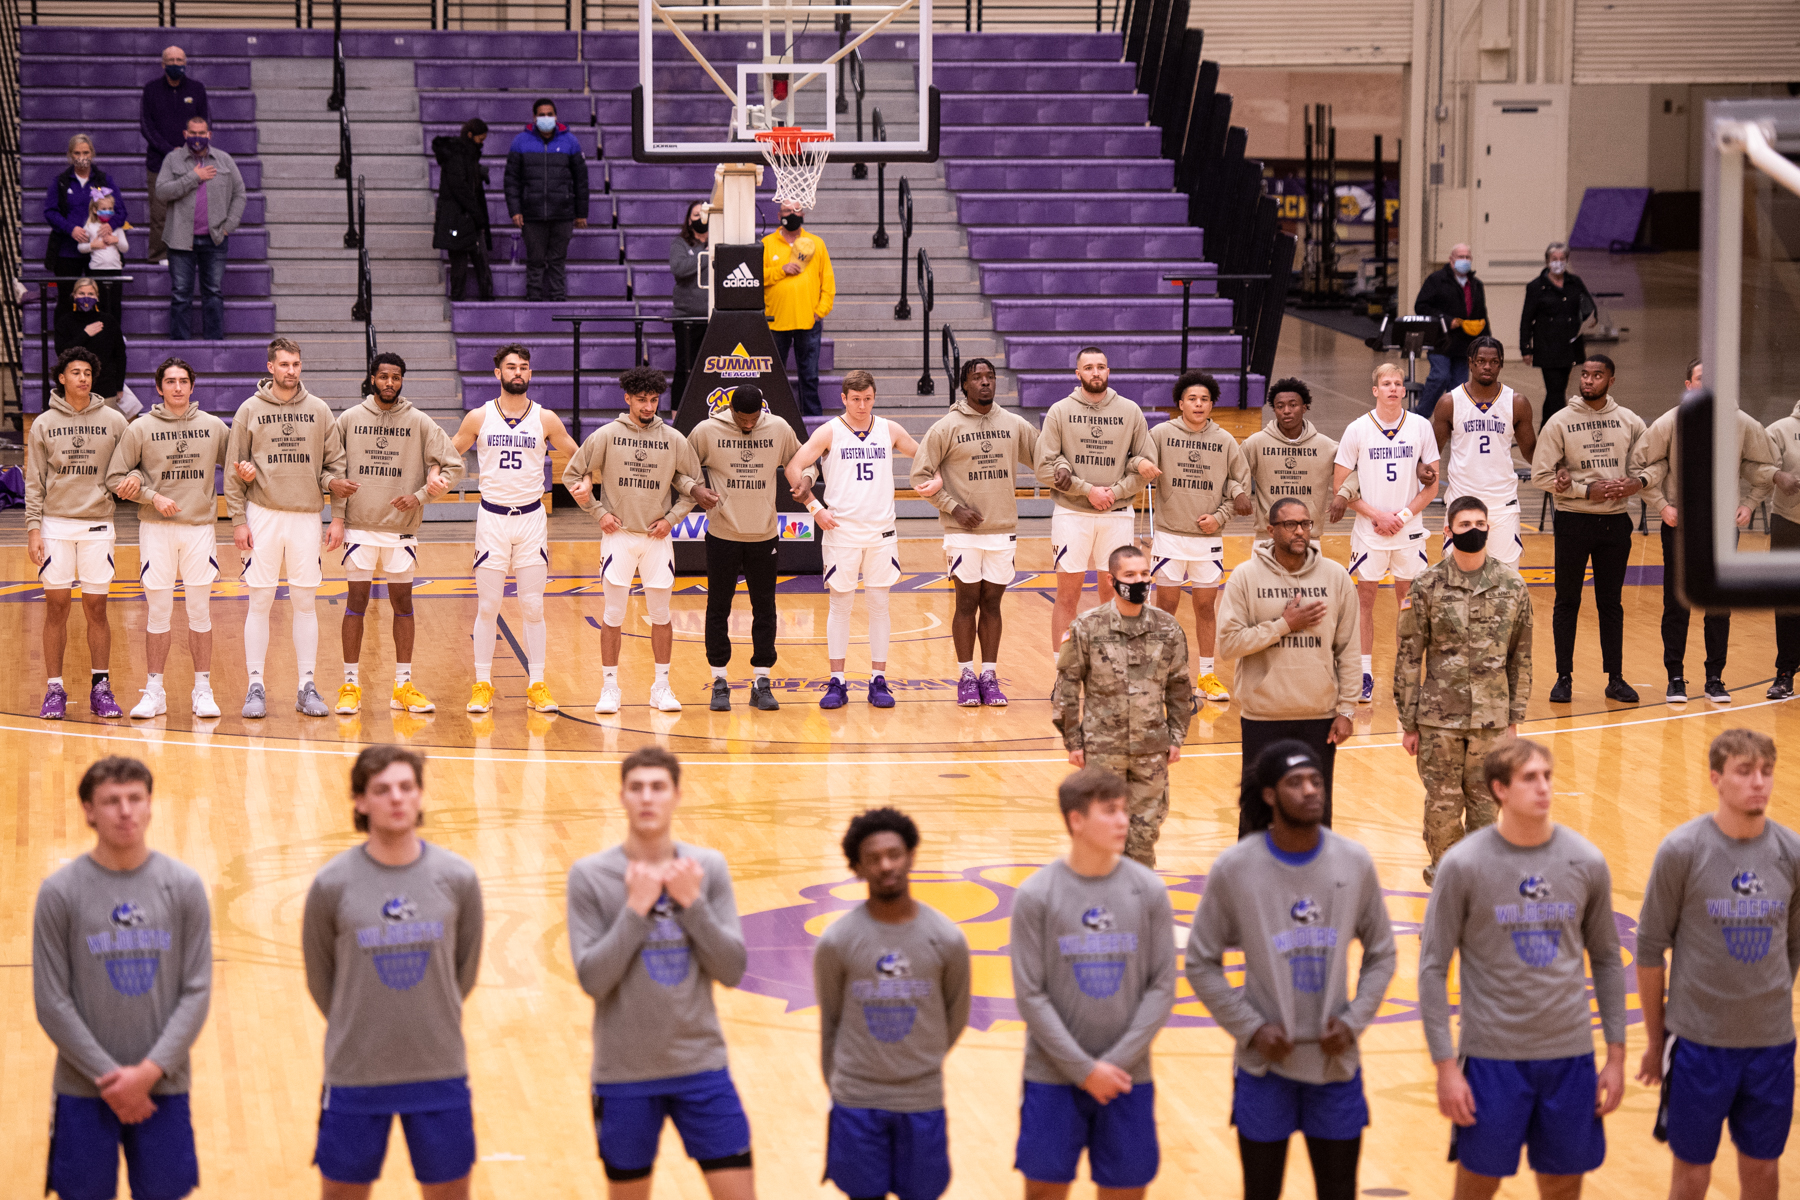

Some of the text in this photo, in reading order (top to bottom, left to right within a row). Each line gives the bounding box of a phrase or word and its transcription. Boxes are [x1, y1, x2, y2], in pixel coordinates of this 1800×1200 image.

[723, 278, 760, 288] adidas
[705, 357, 772, 372] SUMMIT
[258, 414, 314, 424] LEATHERNECK
[1069, 415, 1124, 425] LEATHERNECK
[49, 426, 107, 438] LEATHERNECK
[355, 426, 411, 437] LEATHERNECK
[1463, 420, 1505, 434] WESTERN ILLINOIS
[1568, 419, 1621, 433] LEATHERNECK
[152, 429, 210, 441] LEATHERNECK
[957, 430, 1011, 443] LEATHERNECK
[487, 435, 536, 448] WESTERN ILLINOIS
[614, 437, 669, 450] LEATHERNECK
[718, 439, 774, 448] LEATHERNECK
[1167, 438, 1223, 452] LEATHERNECK
[1480, 436, 1490, 453] 2
[841, 447, 885, 459] WESTERN ILLINOIS
[1263, 447, 1317, 456] LEATHERNECK
[1369, 446, 1413, 460] WESTERN ILLINOIS
[268, 454, 310, 464] BATTALION
[499, 450, 522, 469] 25
[1075, 455, 1115, 466] BATTALION
[1581, 458, 1618, 469] BATTALION
[162, 470, 204, 480] BATTALION
[359, 465, 402, 477] BATTALION
[856, 463, 873, 480] 15
[969, 469, 1008, 480] BATTALION
[1387, 463, 1396, 482] 5
[619, 477, 660, 490] BATTALION
[727, 479, 766, 489] BATTALION
[1172, 478, 1213, 490] BATTALION
[1270, 486, 1311, 495] BATTALION
[1258, 587, 1328, 598] LEATHERNECK
[1269, 636, 1321, 648] ATTALION
[1495, 902, 1577, 924] WILDCATS
[1706, 900, 1786, 917] WILDCATS
